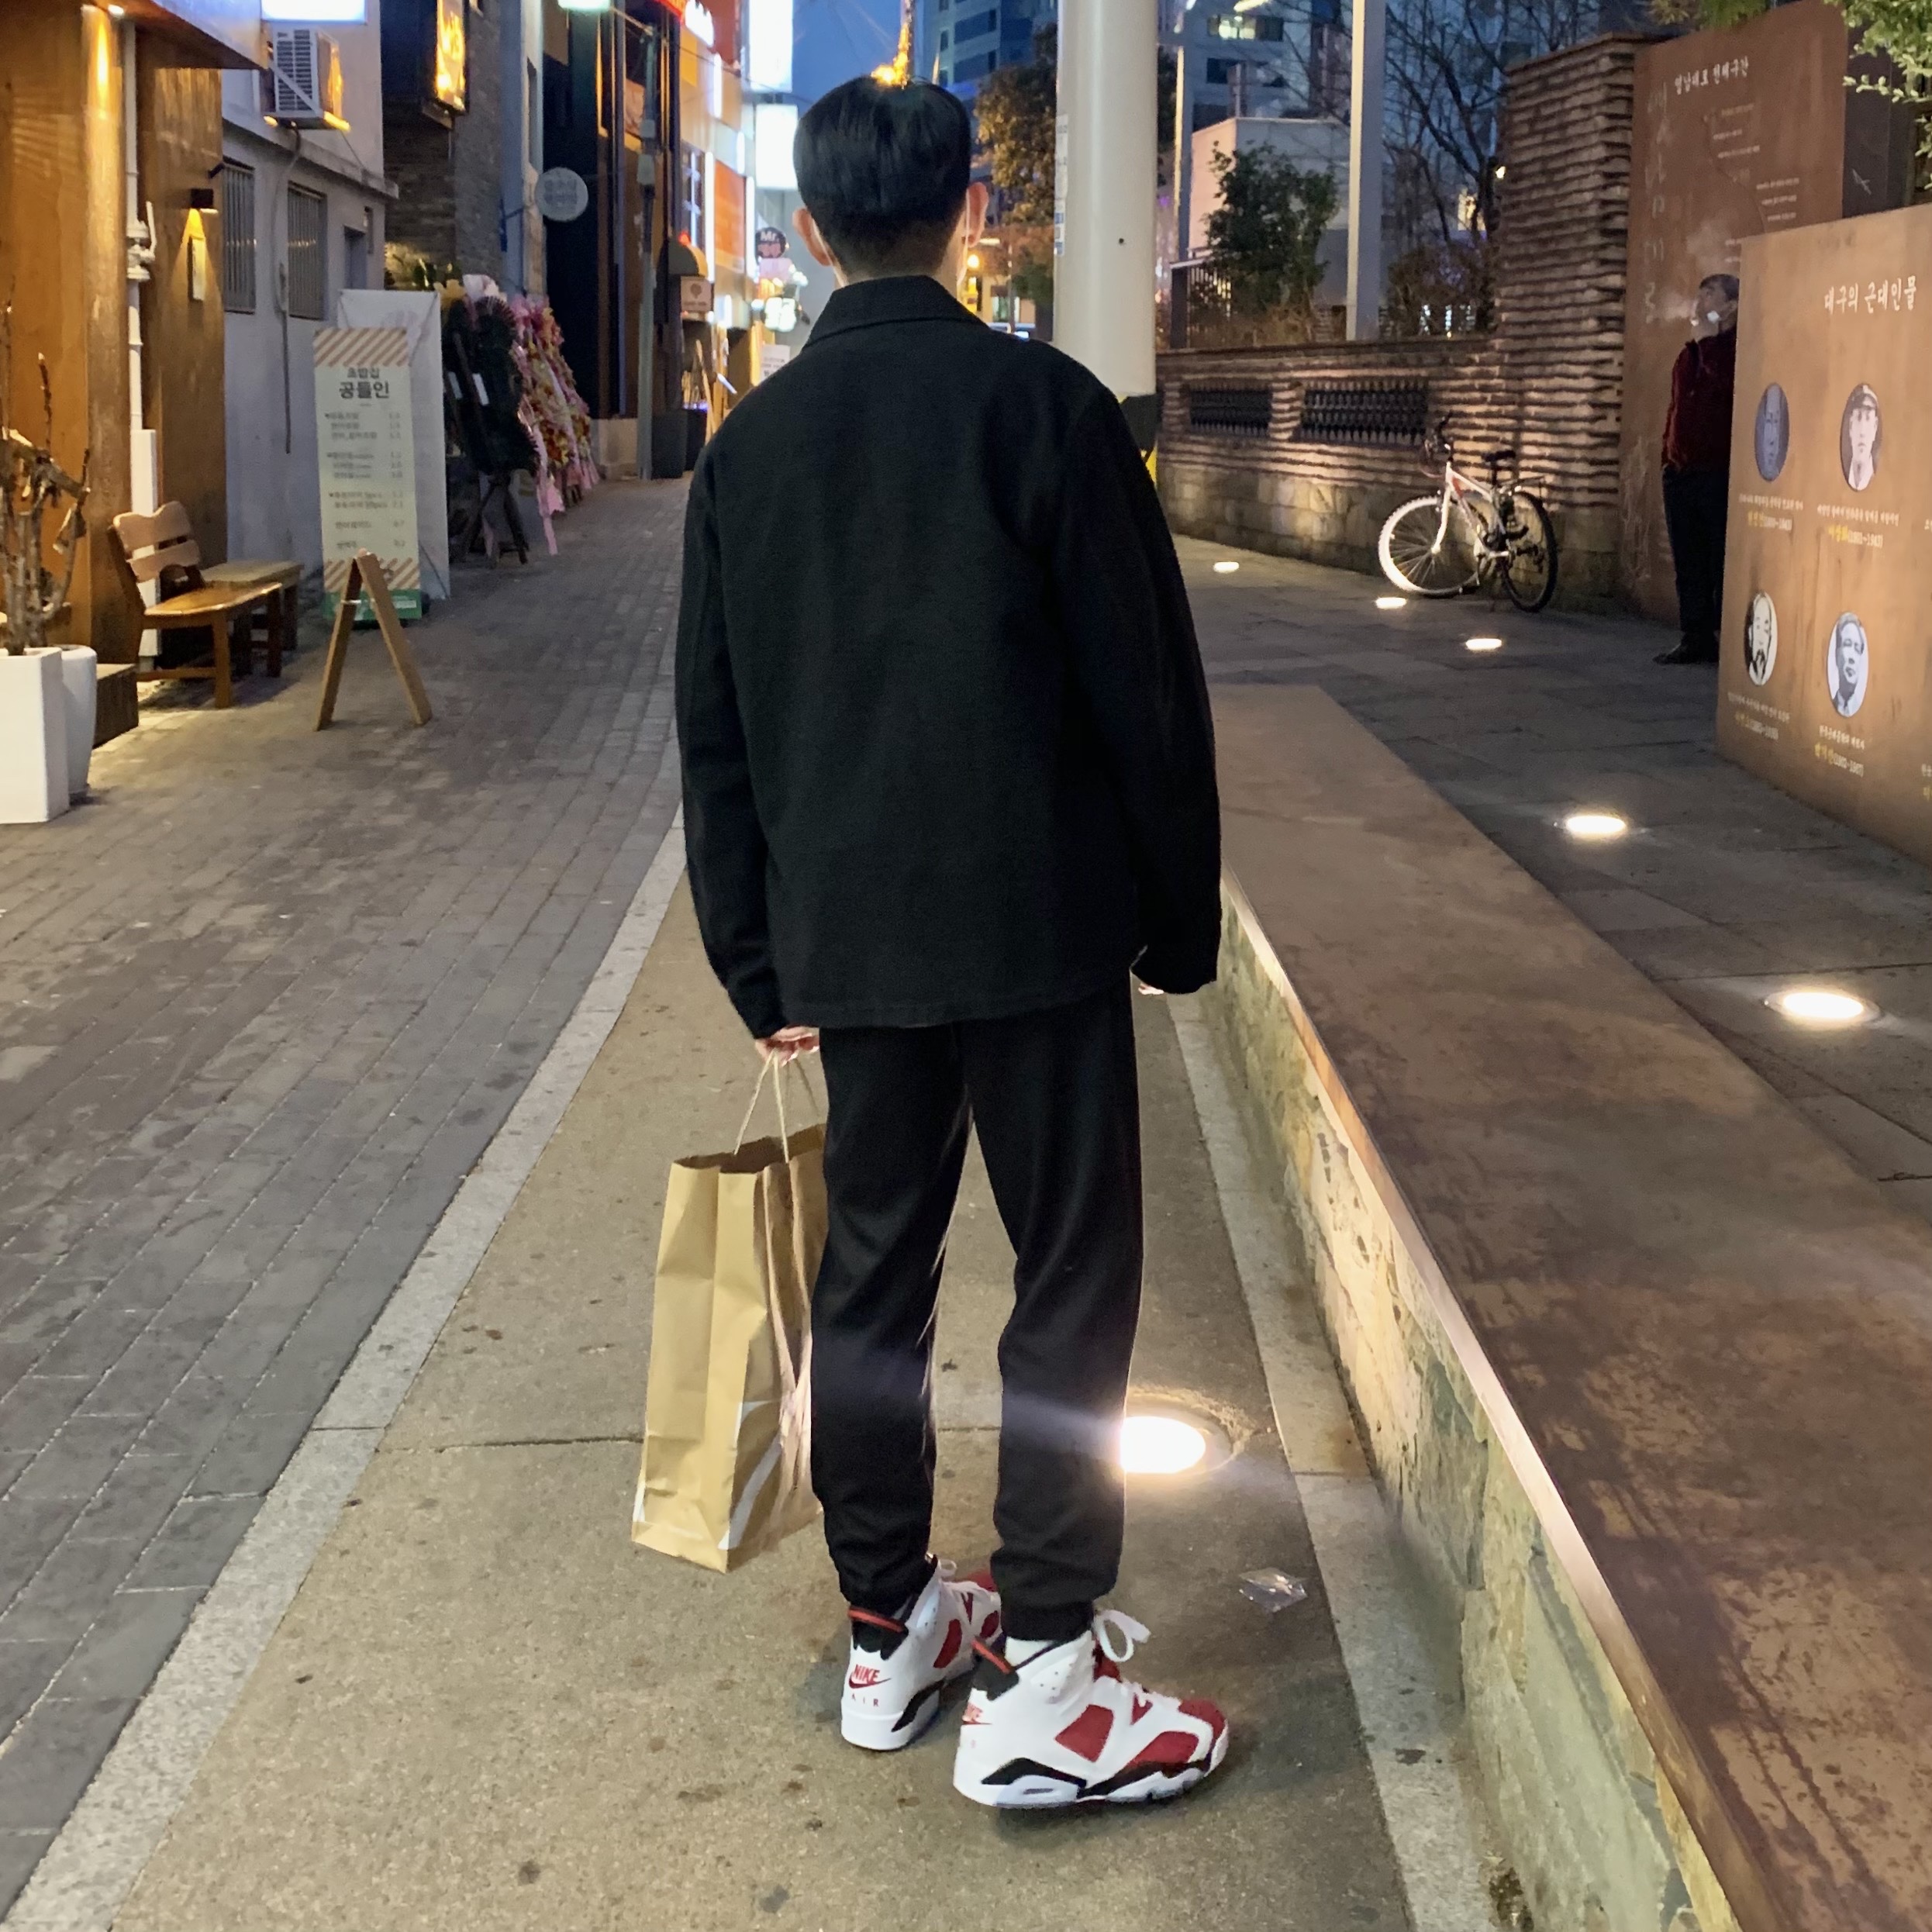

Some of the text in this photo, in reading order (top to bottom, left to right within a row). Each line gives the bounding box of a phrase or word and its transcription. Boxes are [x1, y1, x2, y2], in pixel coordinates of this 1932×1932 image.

[1824, 275, 1916, 315] 대구의 근대인물
[339, 381, 390, 399] 공들인
[854, 1664, 881, 1682] NIKE
